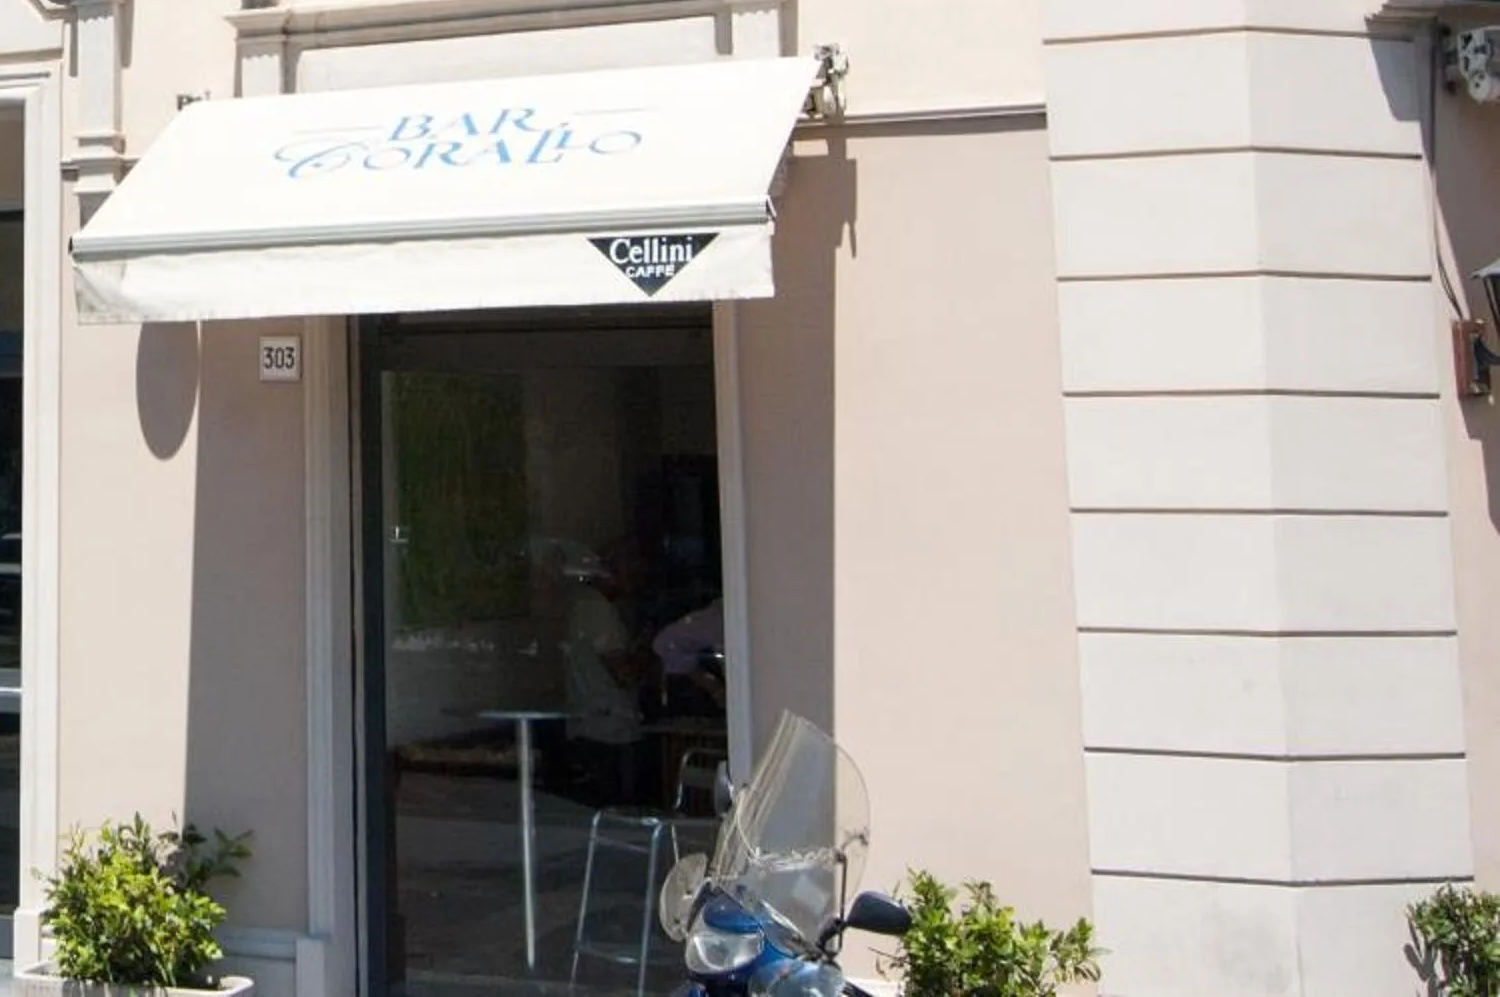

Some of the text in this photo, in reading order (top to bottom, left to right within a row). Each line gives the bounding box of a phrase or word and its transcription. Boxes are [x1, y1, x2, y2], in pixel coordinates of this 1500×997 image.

[387, 106, 540, 142] BAR
[273, 122, 643, 179] CORALLO
[609, 235, 693, 264] Cellini
[263, 346, 295, 370] 303
